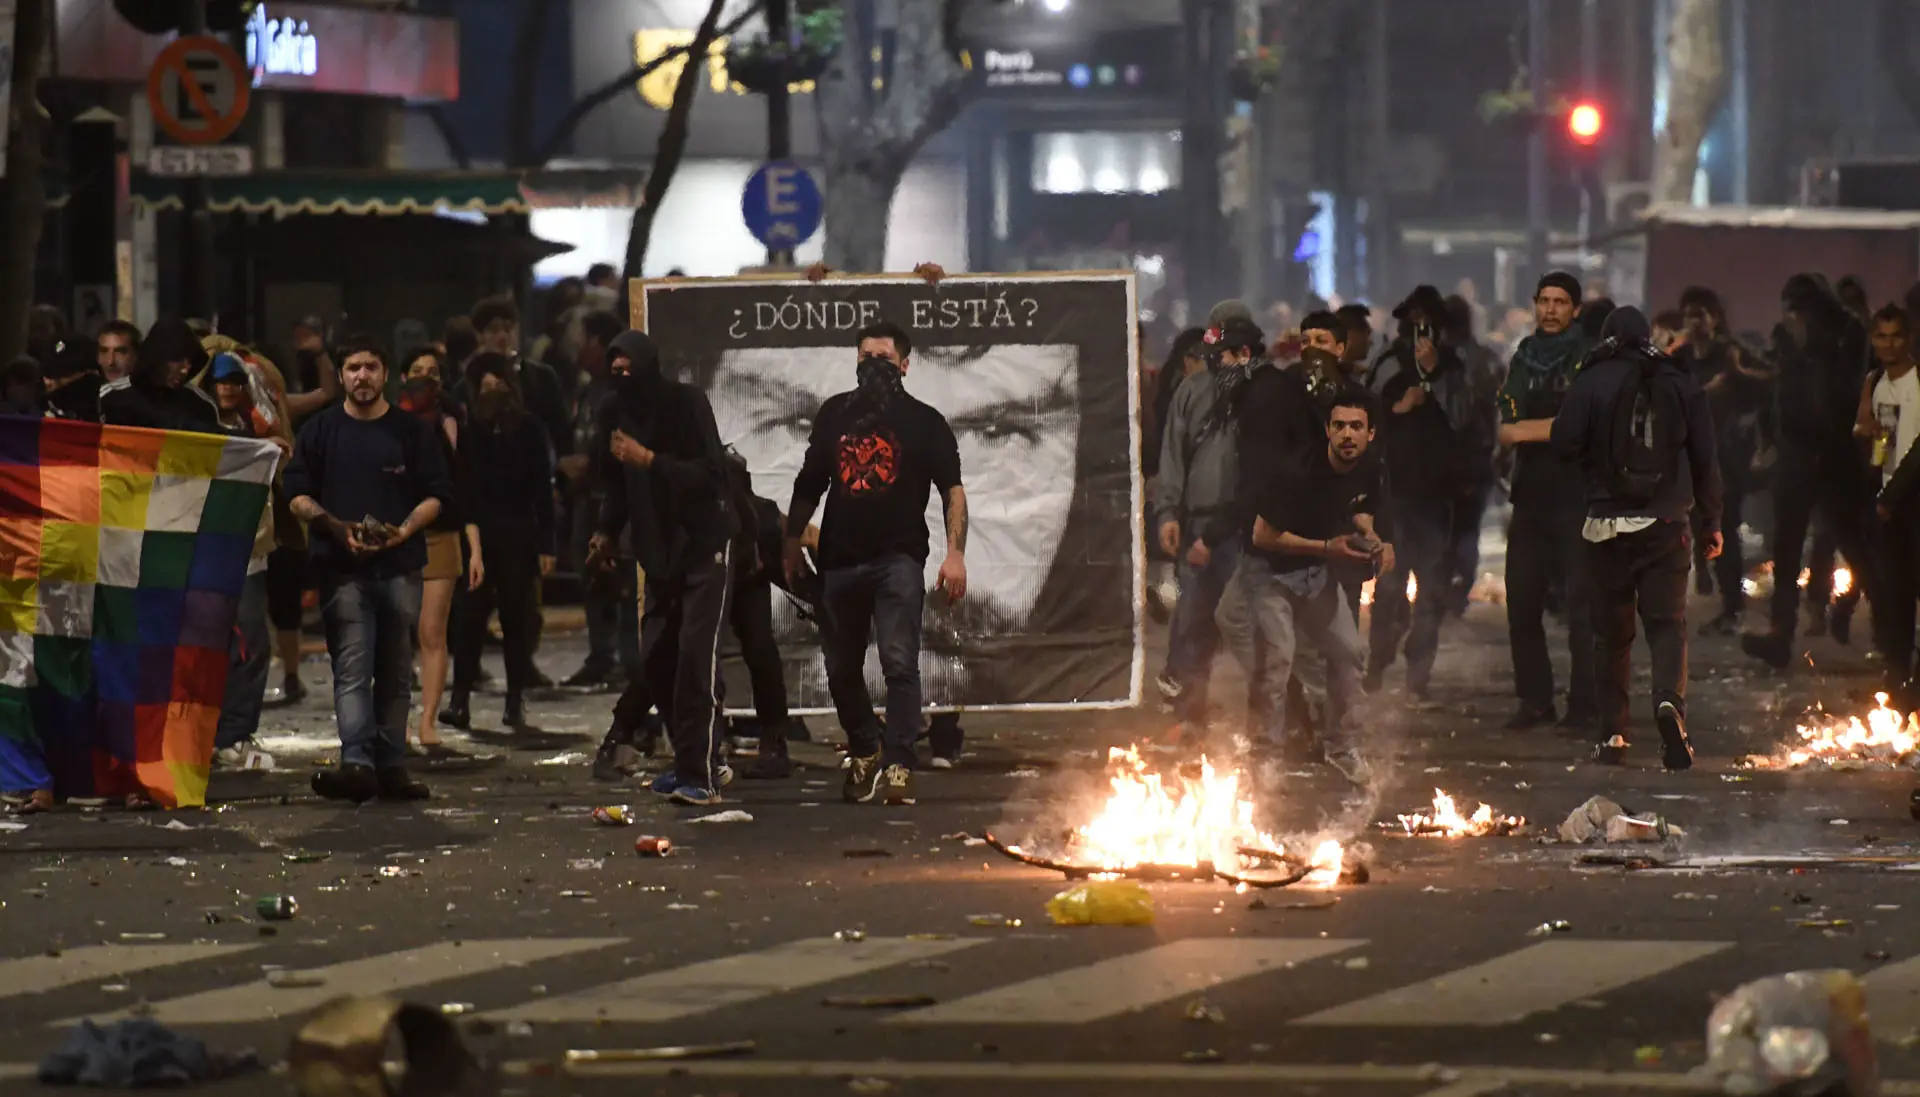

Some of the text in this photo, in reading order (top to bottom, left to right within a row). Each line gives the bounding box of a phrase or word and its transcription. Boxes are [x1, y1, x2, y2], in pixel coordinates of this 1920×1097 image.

[766, 167, 799, 214] E
[728, 291, 1040, 339] ¿DÓNDE ESTÁ?
